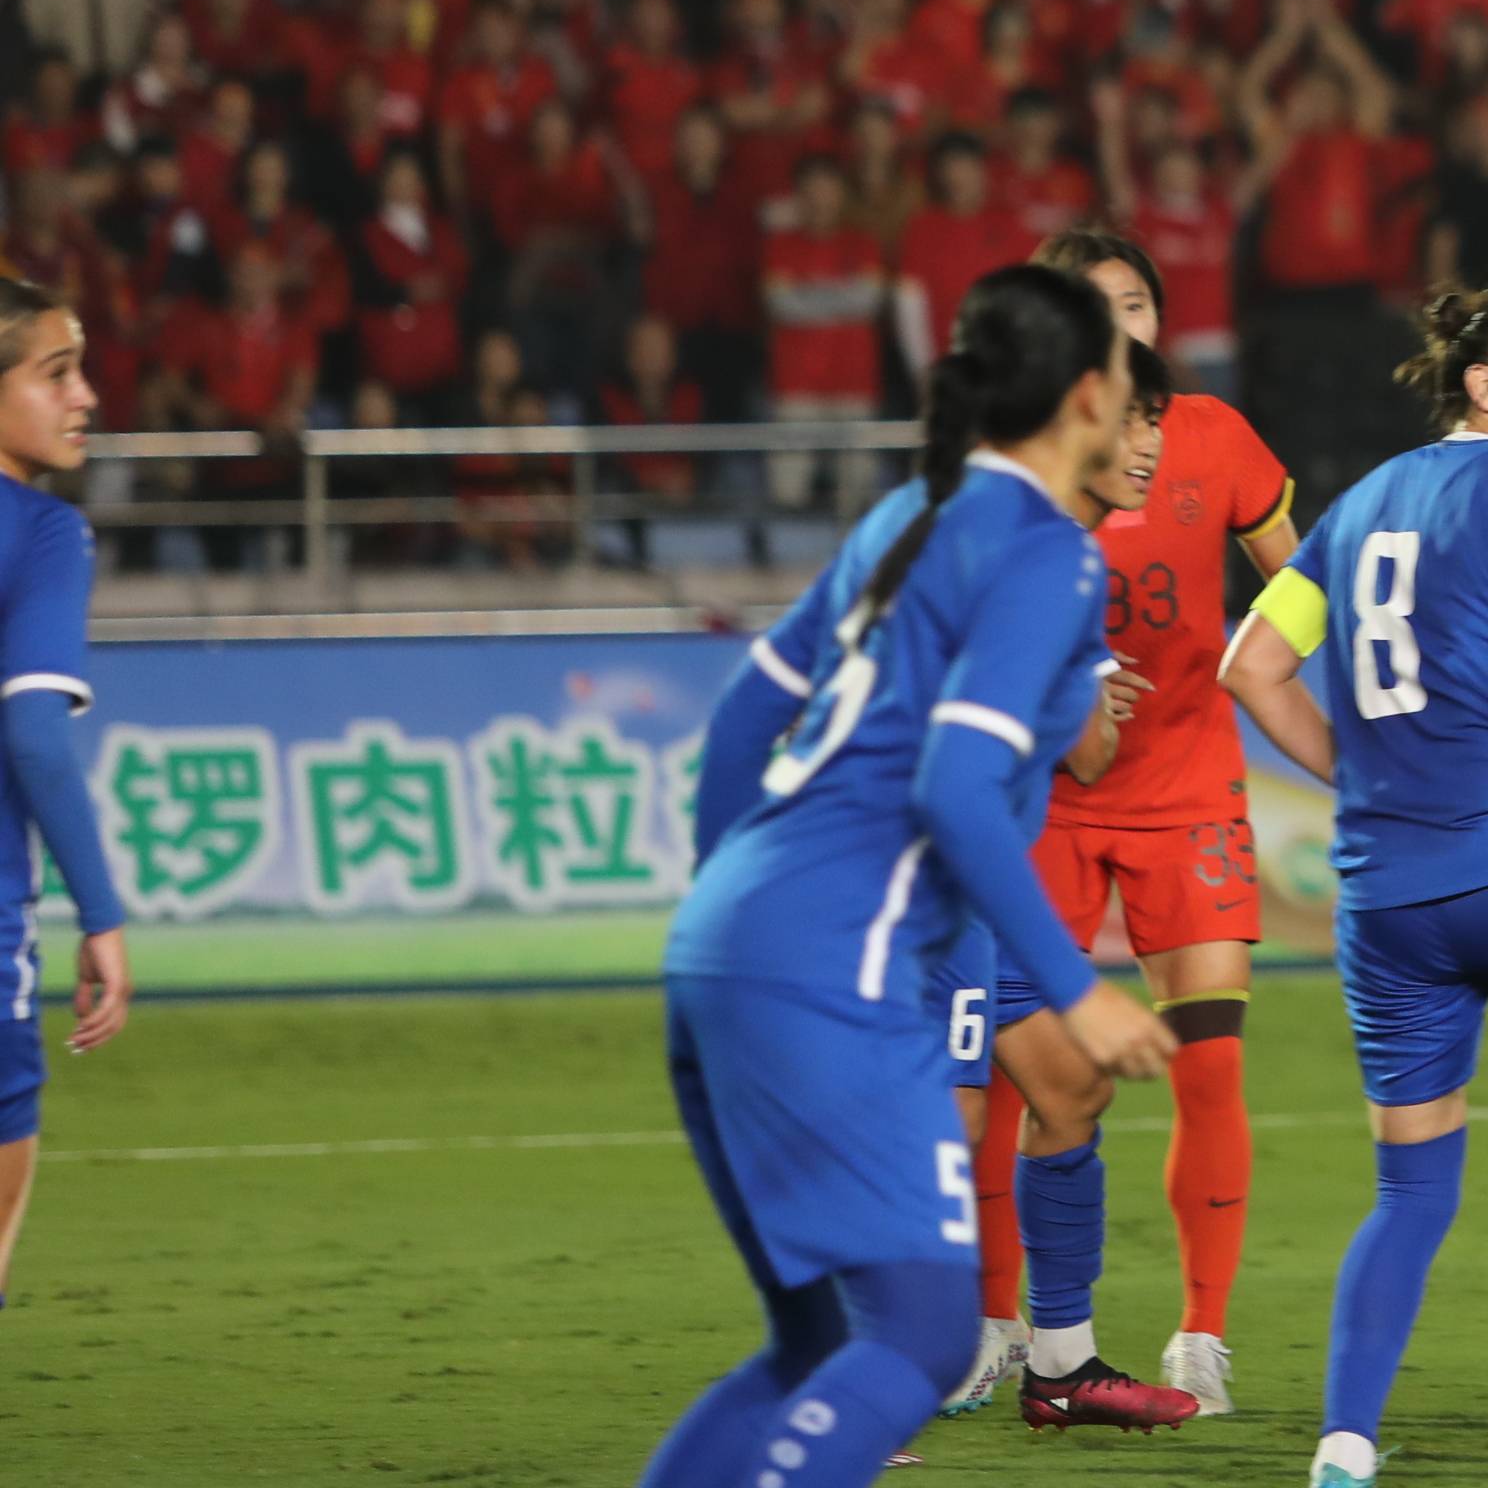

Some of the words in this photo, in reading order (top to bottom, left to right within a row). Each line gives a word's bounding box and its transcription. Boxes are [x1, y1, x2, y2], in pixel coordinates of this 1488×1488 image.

[1104, 561, 1178, 636] 33
[1353, 530, 1428, 720] 8
[42, 734, 697, 897] 锣肉粒
[1189, 818, 1258, 887] 33
[934, 1139, 979, 1246] 5
